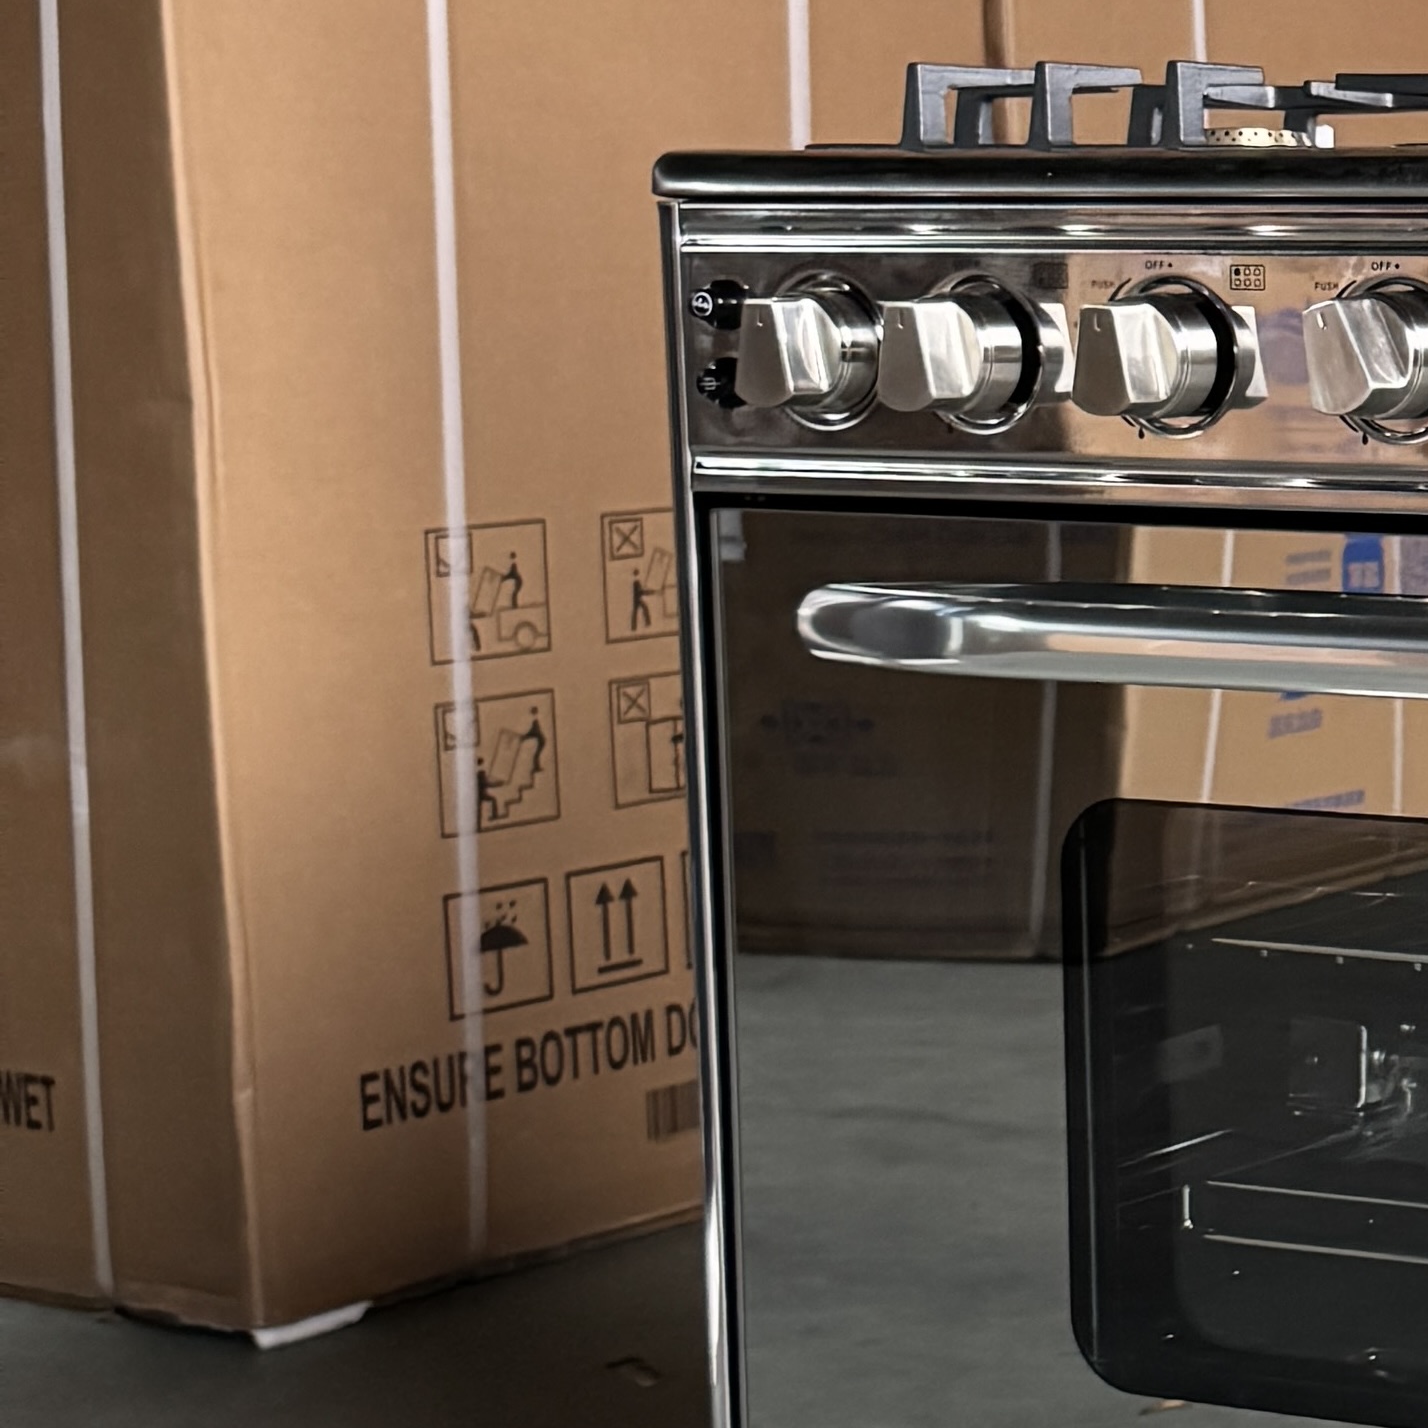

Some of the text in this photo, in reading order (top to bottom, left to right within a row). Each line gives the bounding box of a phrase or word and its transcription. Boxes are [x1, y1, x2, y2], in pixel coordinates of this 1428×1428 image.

[1145, 261, 1165, 270] OFF
[1371, 262, 1391, 271] OFF
[1314, 282, 1339, 291] PUSH
[516, 1018, 656, 1092] BOTTOM
